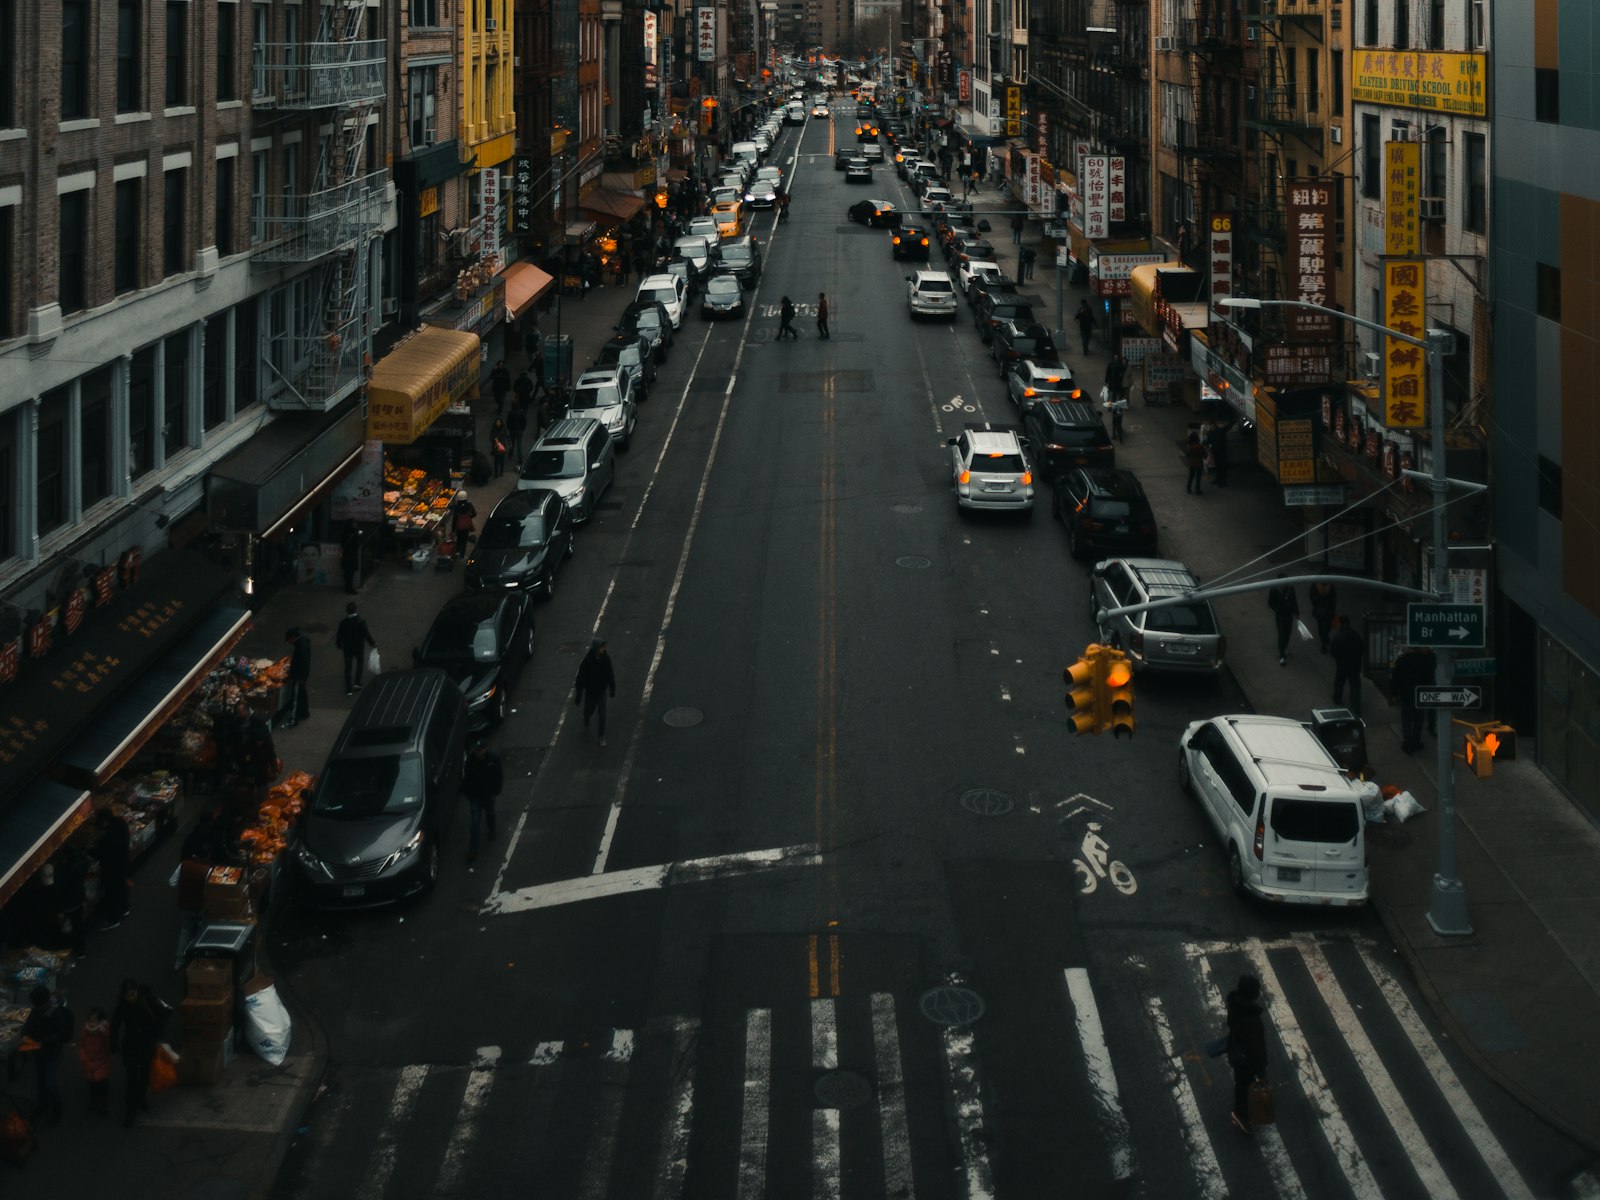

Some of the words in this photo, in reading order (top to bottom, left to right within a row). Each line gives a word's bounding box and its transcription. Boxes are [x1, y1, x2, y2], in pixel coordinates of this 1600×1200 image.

[1360, 76, 1387, 89] EASTERN
[1391, 78, 1419, 92] DRIVING
[1422, 81, 1451, 95] SCHOOL
[1292, 188, 1328, 206] 紐約
[1212, 217, 1231, 231] 66
[1415, 611, 1478, 623] Manhattan
[1421, 626, 1434, 638] Br
[1421, 693, 1441, 702] ONE
[1451, 693, 1472, 702] WAY
